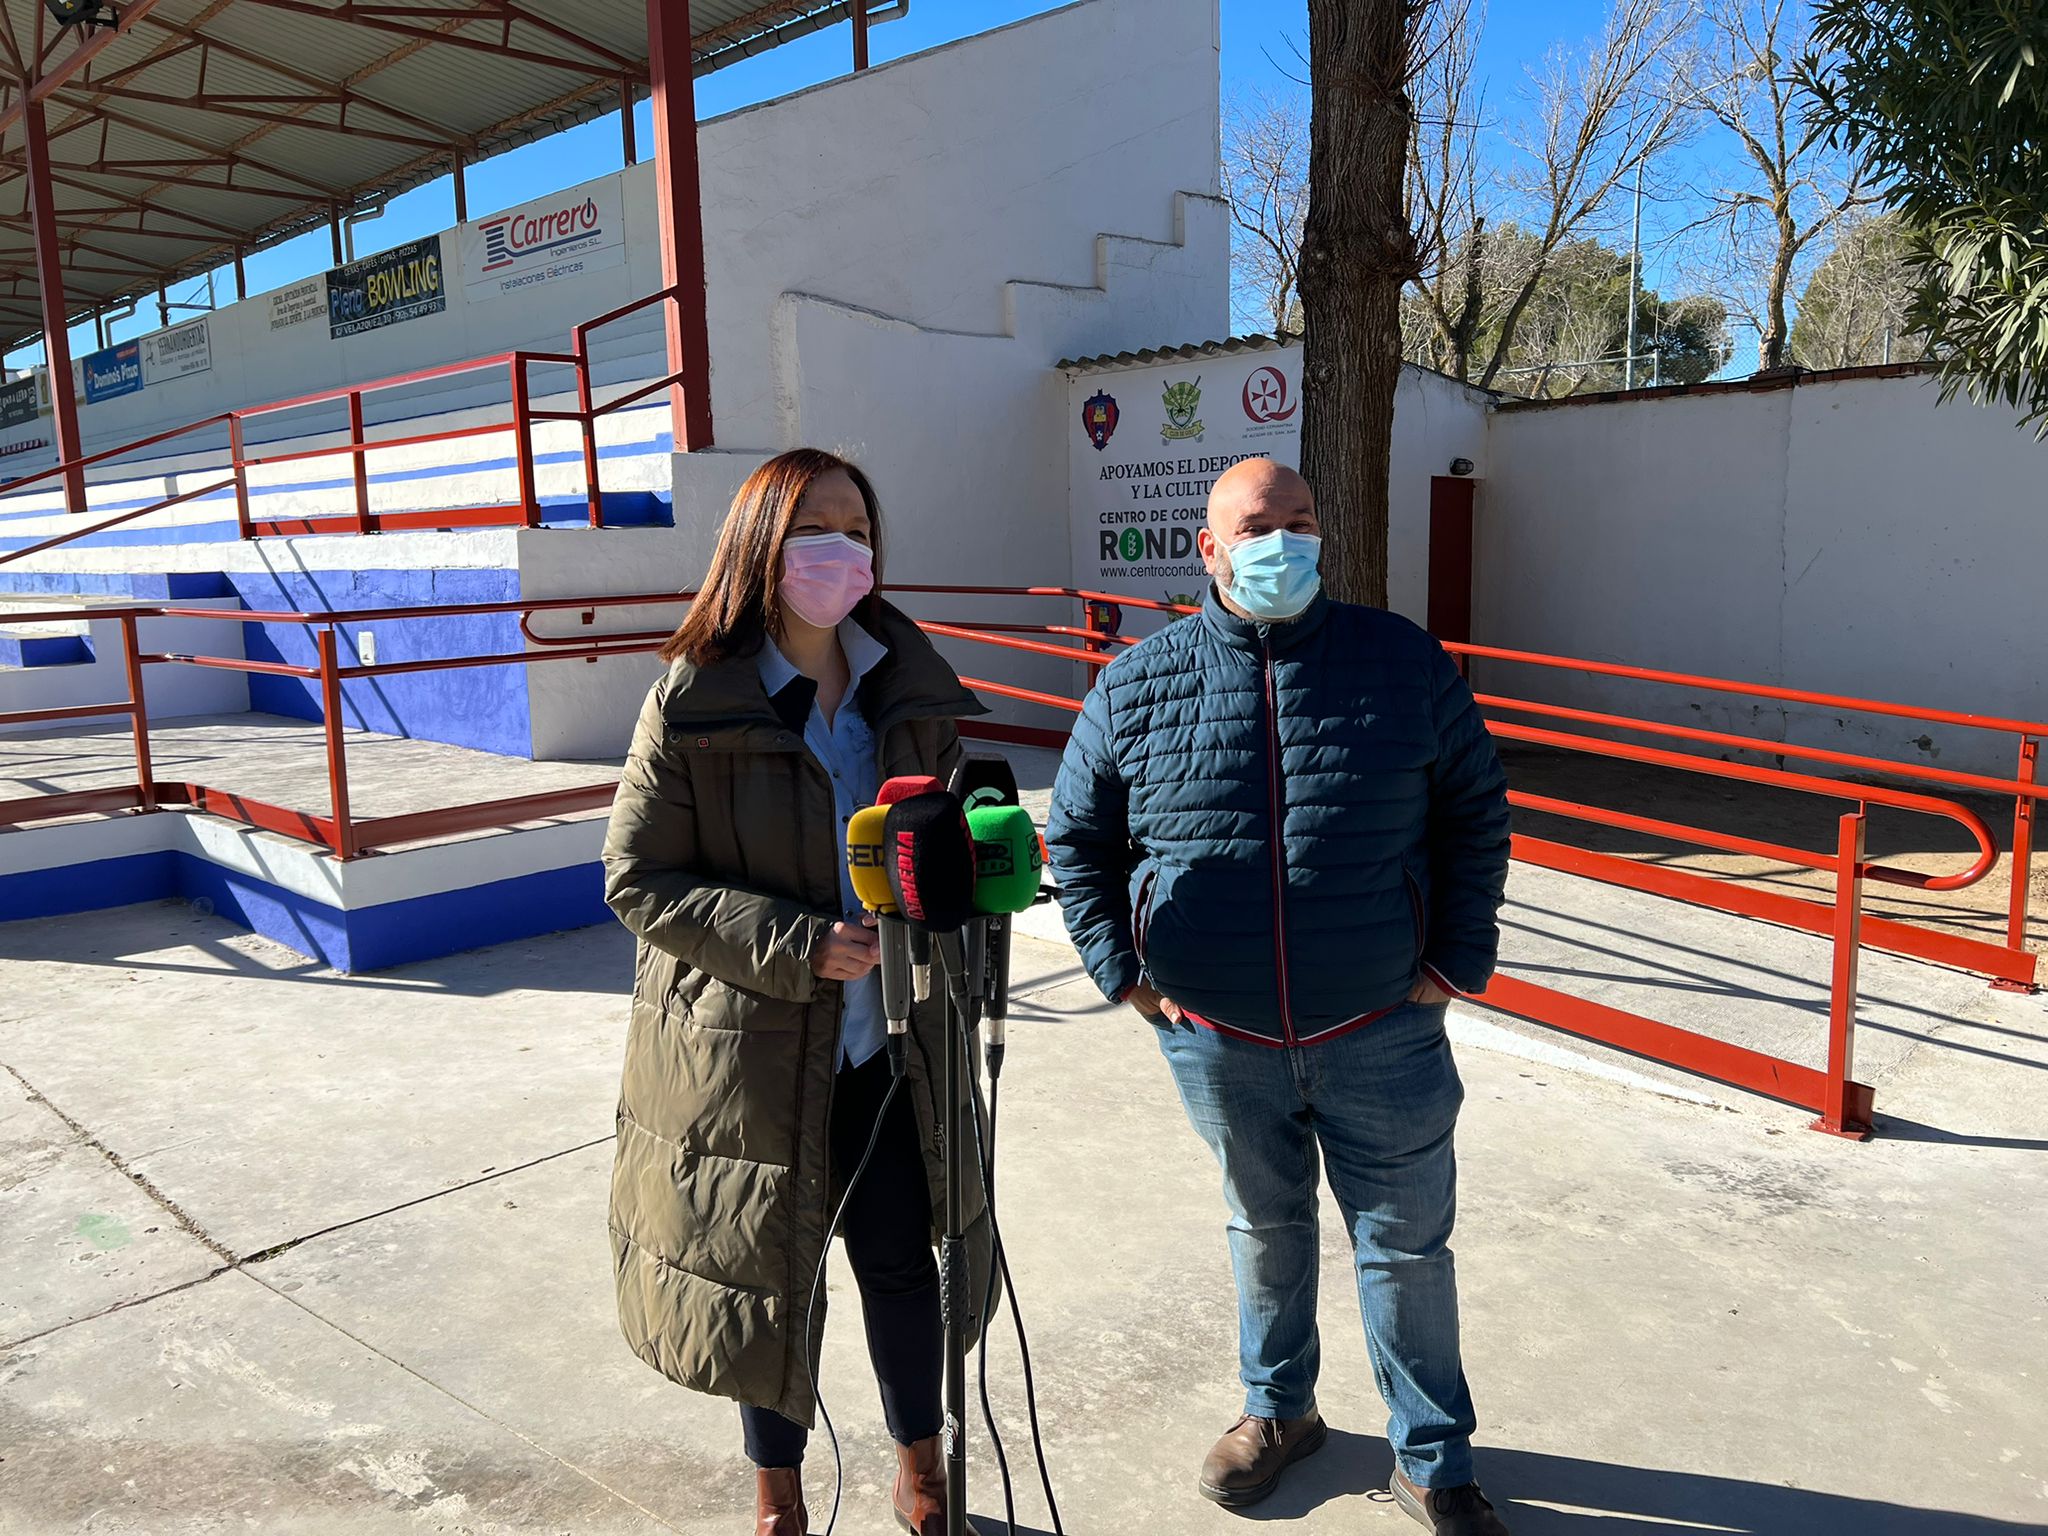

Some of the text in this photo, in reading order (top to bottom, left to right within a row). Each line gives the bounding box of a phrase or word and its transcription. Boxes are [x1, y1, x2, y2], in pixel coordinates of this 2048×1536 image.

[511, 197, 598, 249] Carrero
[399, 245, 417, 257] PIZZAS
[550, 241, 588, 257] Ingenieros
[367, 255, 439, 308] BOWLING
[500, 272, 545, 290] Instalaciones
[1099, 452, 1270, 480] APOYAMOS EL DEPO
[1131, 480, 1216, 499] Y LA CULTU
[1099, 507, 1208, 524] CENTRO DE COND
[1100, 563, 1208, 578] www.centroconduc
